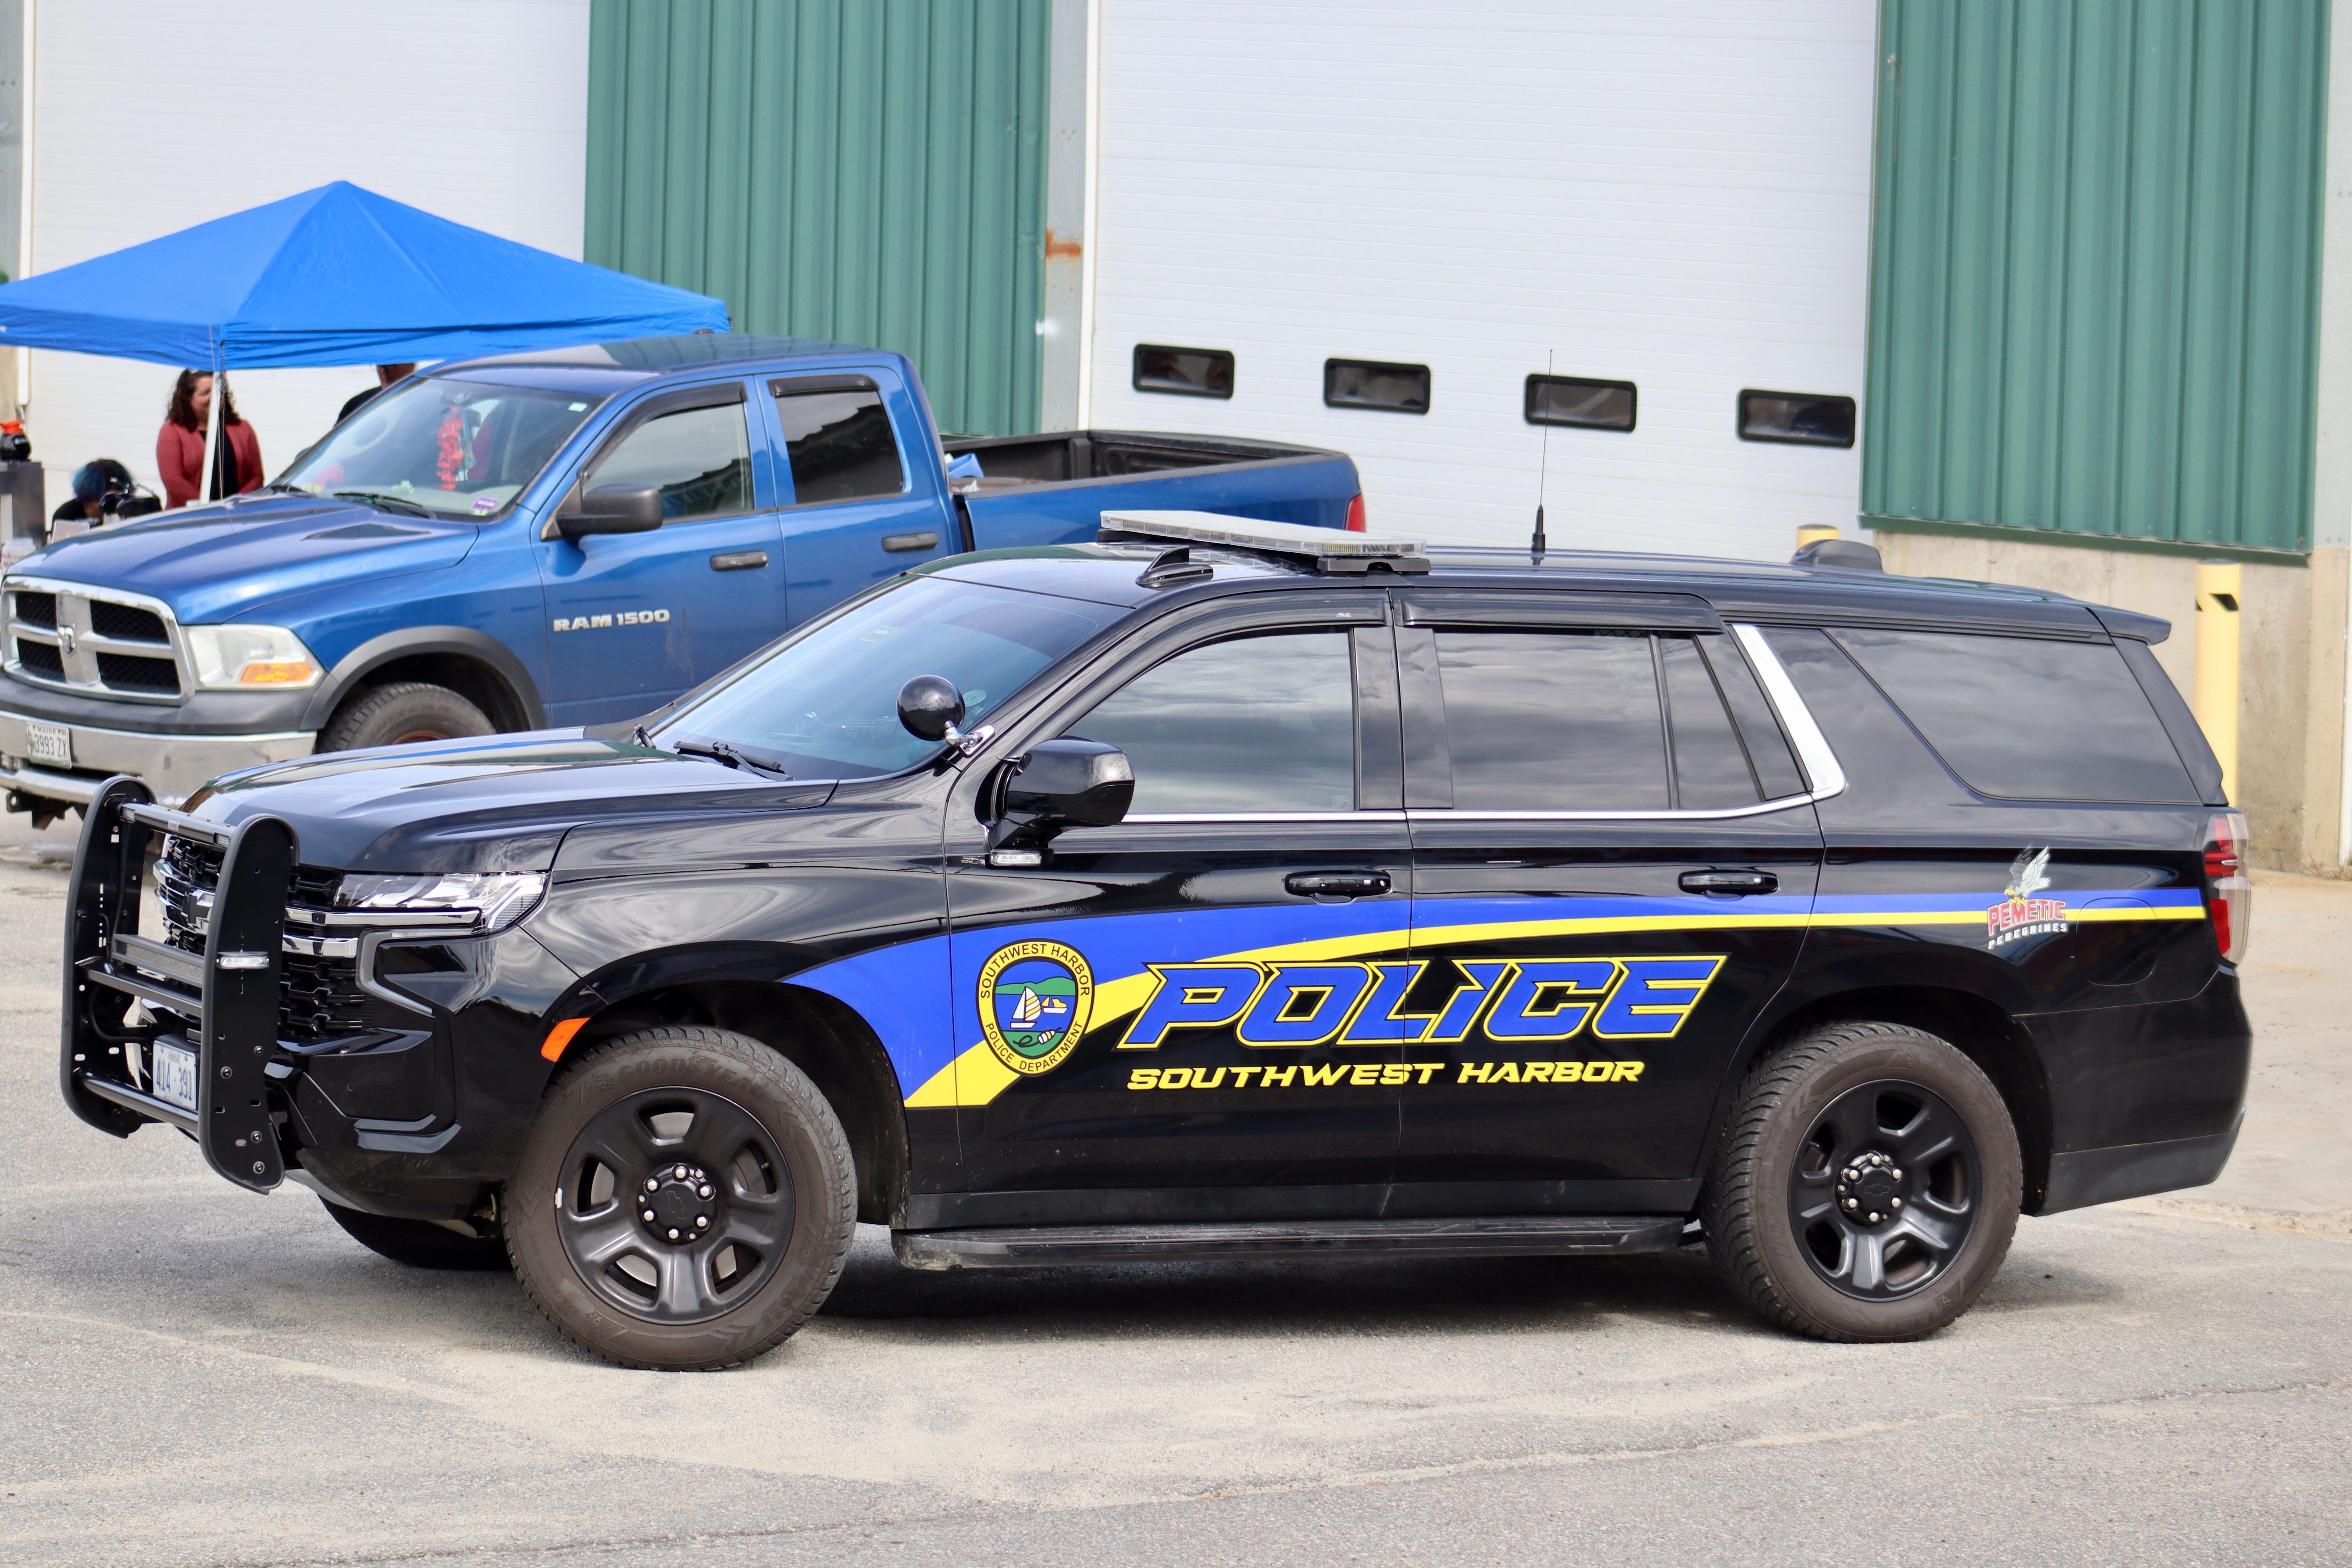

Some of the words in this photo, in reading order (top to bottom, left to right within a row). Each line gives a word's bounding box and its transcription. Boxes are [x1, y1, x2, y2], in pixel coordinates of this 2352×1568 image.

[553, 614, 612, 632] RAM
[616, 609, 670, 625] 1500
[34, 733, 55, 756] 3993
[57, 738, 68, 758] ZX
[1987, 899, 2066, 937] PEMETIC
[1987, 923, 2068, 950] PEREGRINES
[980, 944, 1047, 998] SOUTHWEST
[1051, 945, 1090, 996] HARBOR
[1116, 955, 1728, 1049] POLICE
[985, 1023, 1014, 1063] POLICE
[1019, 1021, 1083, 1072] DEPARTMENT
[156, 1057, 171, 1093] 414
[178, 1065, 192, 1102] 391
[618, 1055, 768, 1102] GOODYEAR
[1127, 1063, 1445, 1090] SOUTHWEST
[1457, 1061, 1644, 1083] HARBOR
